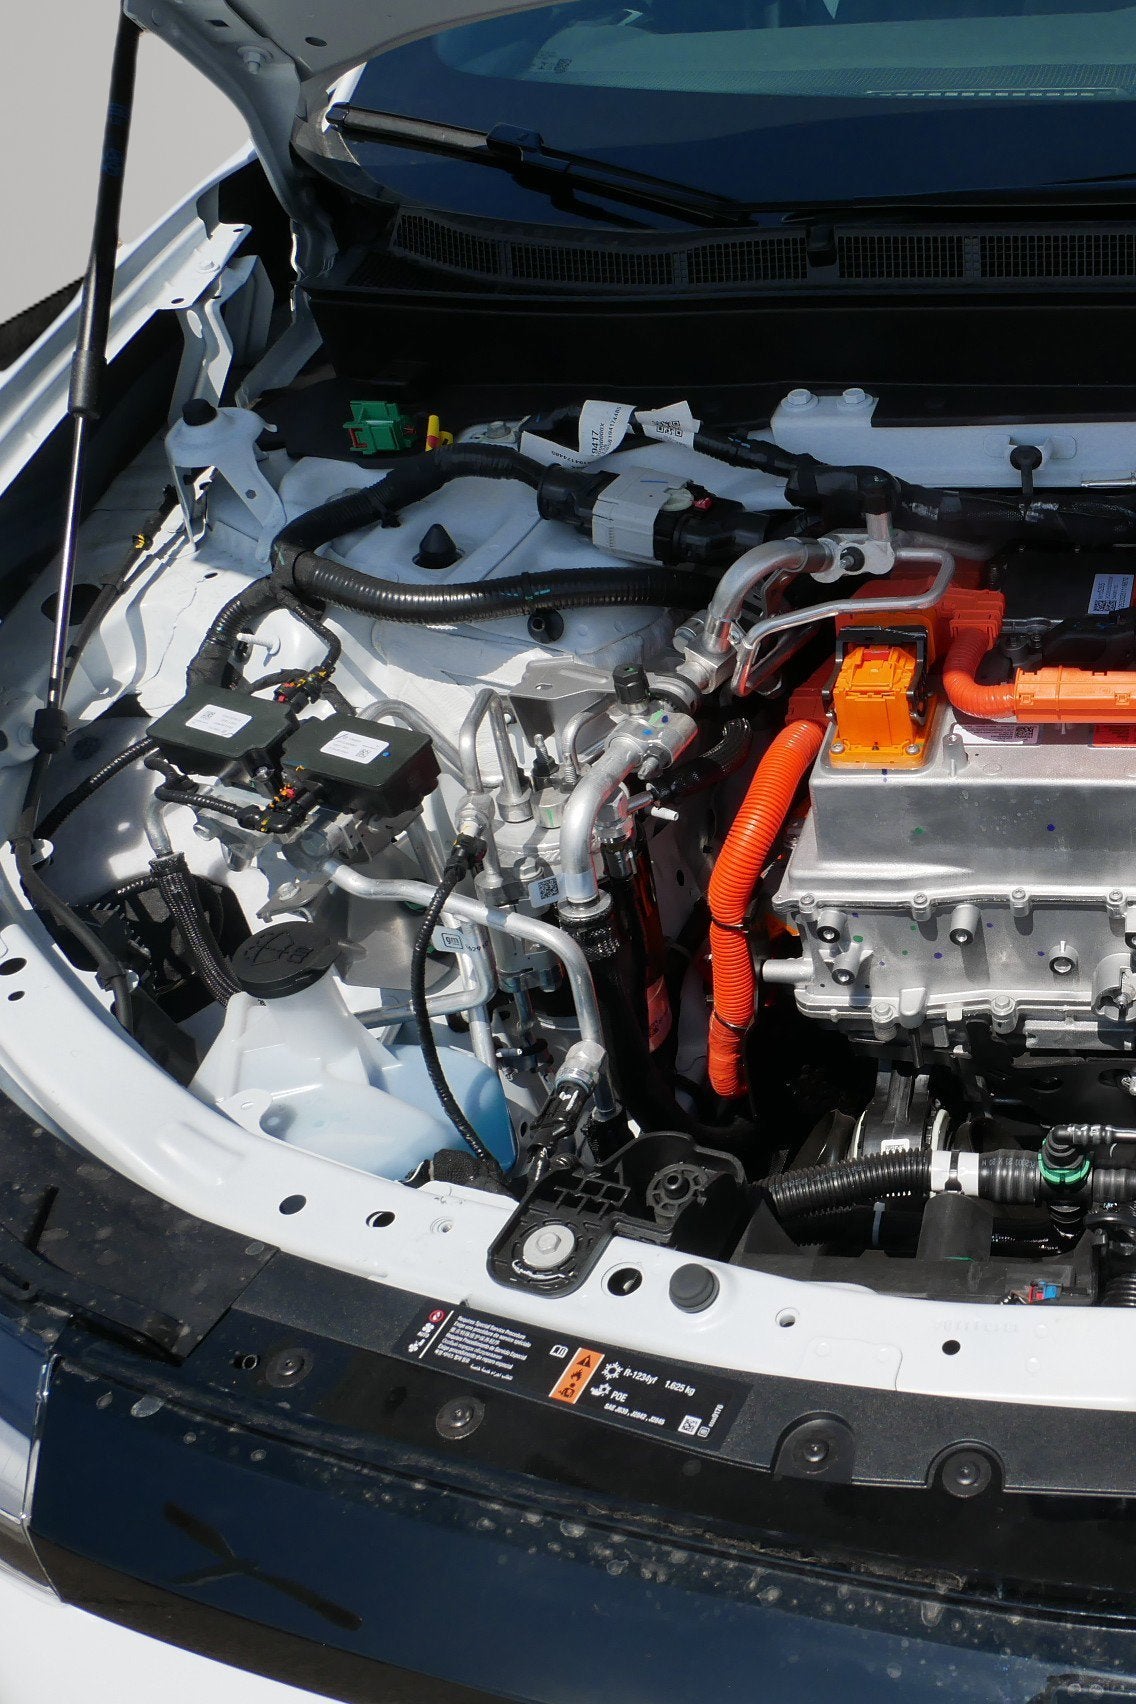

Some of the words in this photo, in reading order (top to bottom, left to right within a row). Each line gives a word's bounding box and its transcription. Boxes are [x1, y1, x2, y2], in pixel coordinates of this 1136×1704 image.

[624, 1369, 657, 1384] R-1234yf
[665, 1381, 685, 1392] 1.625
[685, 1386, 695, 1396] kg
[611, 1391, 627, 1402] POE
